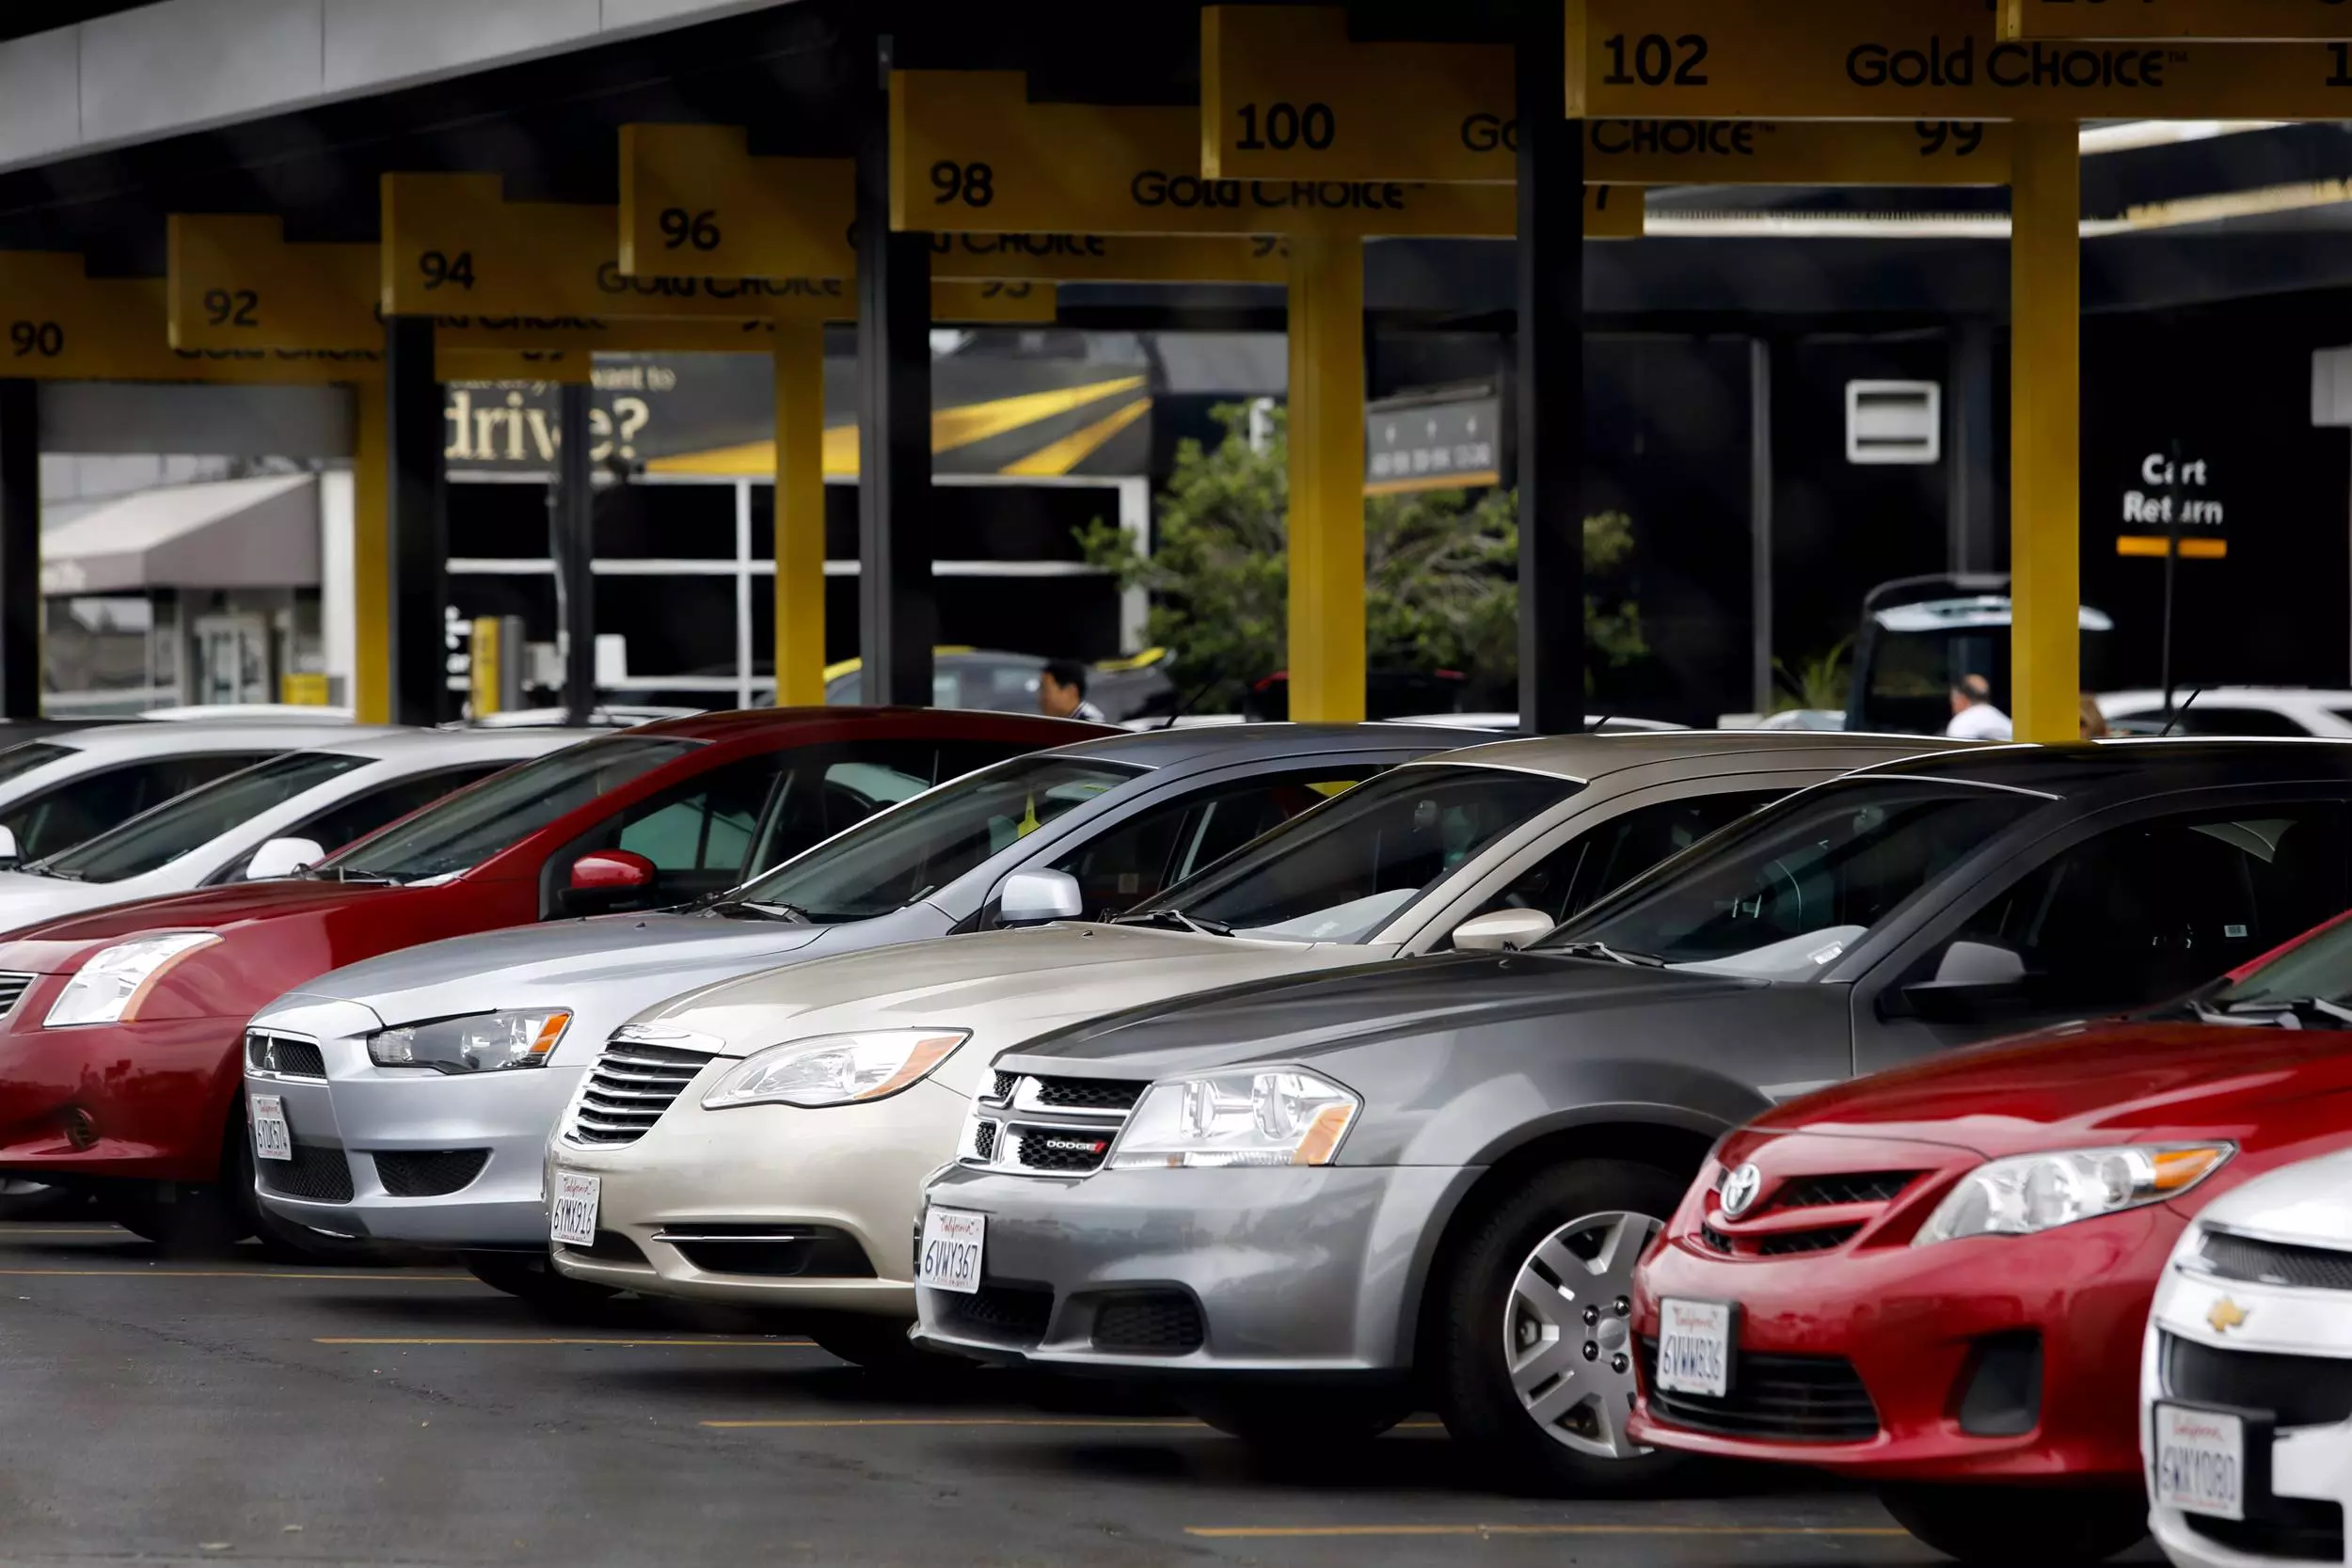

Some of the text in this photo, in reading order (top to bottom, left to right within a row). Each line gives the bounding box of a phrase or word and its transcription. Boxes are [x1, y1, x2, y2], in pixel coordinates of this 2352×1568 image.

[1603, 35, 1708, 86] 102
[1846, 36, 1974, 87] Gold
[1236, 103, 1335, 150] 100
[930, 160, 993, 207] 98
[660, 209, 721, 250] 96
[420, 250, 475, 290] 94
[204, 289, 259, 327] 92
[10, 321, 65, 356] 90
[1046, 1139, 1097, 1151] DODGE
[553, 1197, 596, 1235] 6YMX916
[925, 1240, 978, 1280] 6VWY367
